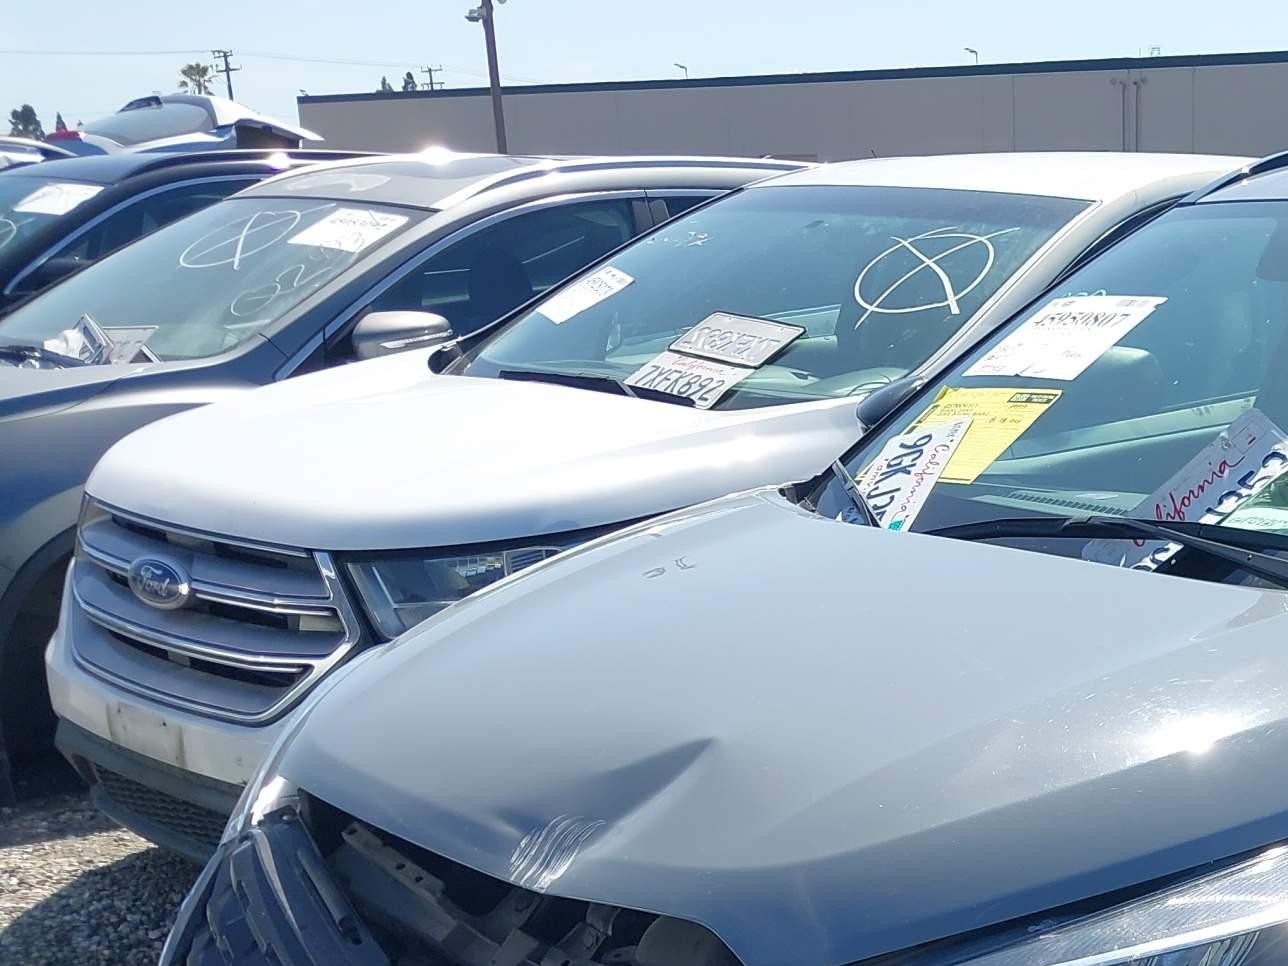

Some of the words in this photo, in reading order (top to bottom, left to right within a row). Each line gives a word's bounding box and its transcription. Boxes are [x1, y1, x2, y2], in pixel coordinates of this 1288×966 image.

[1032, 310, 1132, 328] 45950807
[633, 364, 727, 402] 7XFK892
[890, 444, 950, 521] California
[140, 565, 170, 597] Ford
